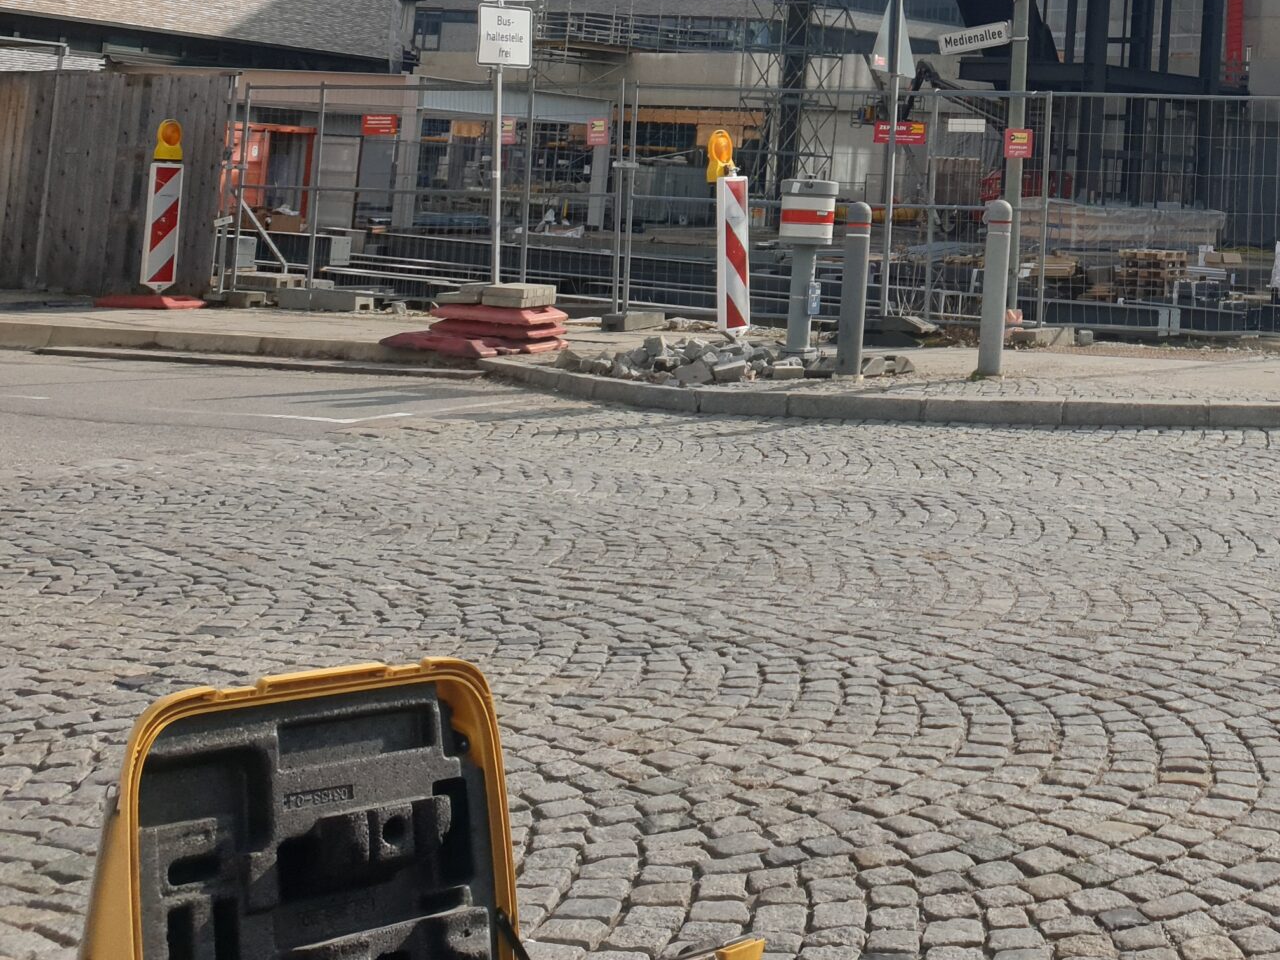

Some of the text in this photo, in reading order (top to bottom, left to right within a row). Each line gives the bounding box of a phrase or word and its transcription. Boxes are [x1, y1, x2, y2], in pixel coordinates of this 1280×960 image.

[497, 15, 515, 26] Bus-
[486, 31, 524, 43] haltestelle
[944, 29, 1003, 48] Medienallee
[498, 47, 512, 58] frei
